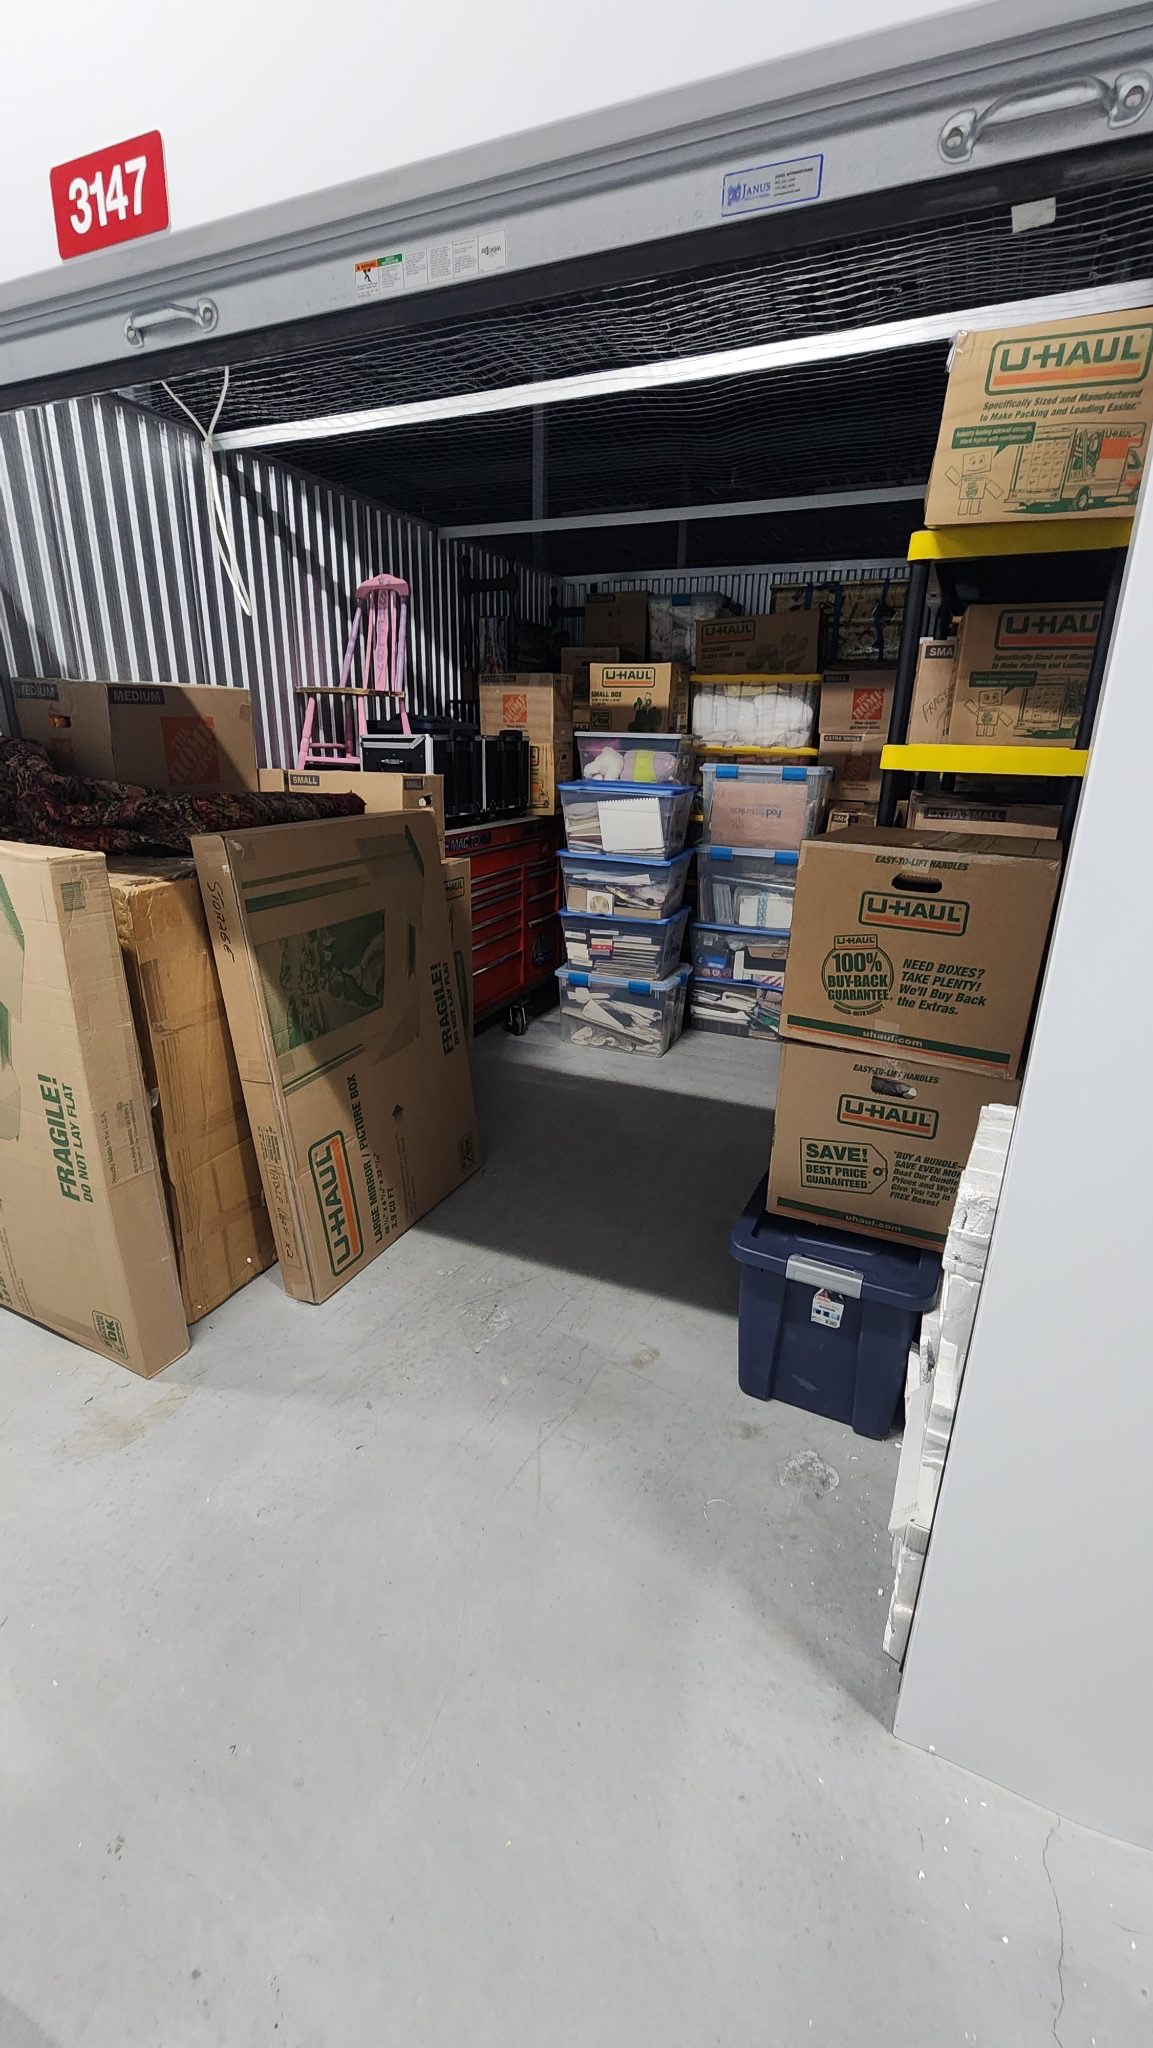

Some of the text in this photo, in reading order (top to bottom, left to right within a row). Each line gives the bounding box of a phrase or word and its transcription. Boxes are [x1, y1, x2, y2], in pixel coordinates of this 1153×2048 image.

[69, 154, 147, 234] 3147
[742, 181, 771, 200] JANUS
[1000, 335, 1141, 372] U-HAUL
[983, 388, 1143, 411] Specifically Sized and Manufactured
[990, 412, 1013, 422] Make
[1014, 408, 1049, 420] Packing
[1050, 405, 1068, 416] and
[1069, 402, 1105, 415] Loading
[705, 623, 751, 636] U-HAUL
[1005, 613, 1100, 634] U-HAU
[929, 646, 953, 657] SMA
[605, 670, 652, 680] U-HAUL
[113, 691, 161, 702] MEDIUM
[852, 688, 884, 719] HOME
[292, 776, 318, 784] SMALL
[926, 808, 1001, 820] EXTRA SMALL
[875, 855, 970, 871] EASY-TO-LIFT HANDLES
[867, 897, 961, 923] U-HAUL
[207, 881, 235, 963] STORAGE
[837, 936, 875, 945] U-HAUL
[832, 952, 882, 973] 100%
[902, 958, 986, 979] NEED BOXES?
[828, 974, 888, 988] BUY-BACK
[901, 971, 982, 992] TAKE PLENTY!
[899, 983, 988, 1007] We'll Buy Back
[431, 962, 454, 1056] FRAGILE!
[896, 996, 959, 1016] the Extras.
[863, 1030, 923, 1047] uhaul.com
[347, 1072, 359, 1099] BOX
[903, 1072, 939, 1084] HANDLES
[845, 1100, 931, 1127] U-HAUL
[351, 1101, 369, 1151] PICTURE
[37, 1073, 81, 1202] FRAGILE!
[62, 1083, 94, 1203] DO NOT LAY FLAT
[806, 1143, 867, 1164] SAVE!
[806, 1164, 867, 1178] BEST PRICE
[893, 1168, 960, 1186] Beat Our Bundle
[894, 1160, 961, 1178] SAVE EVEN MOR
[363, 1160, 379, 1204] MIRROR
[891, 1184, 908, 1192] Give
[911, 1187, 925, 1196] You
[927, 1191, 940, 1199] $20
[892, 1176, 917, 1186] Prices
[919, 1182, 935, 1190] and
[386, 1187, 394, 1199] FT
[890, 1191, 939, 1207] FREE Boxes!
[316, 1145, 350, 1265] U-HAUL
[389, 1201, 397, 1217] CU
[371, 1205, 383, 1244] LARGE
[845, 1213, 902, 1233] uhaul.com
[105, 1320, 118, 1343] OK
